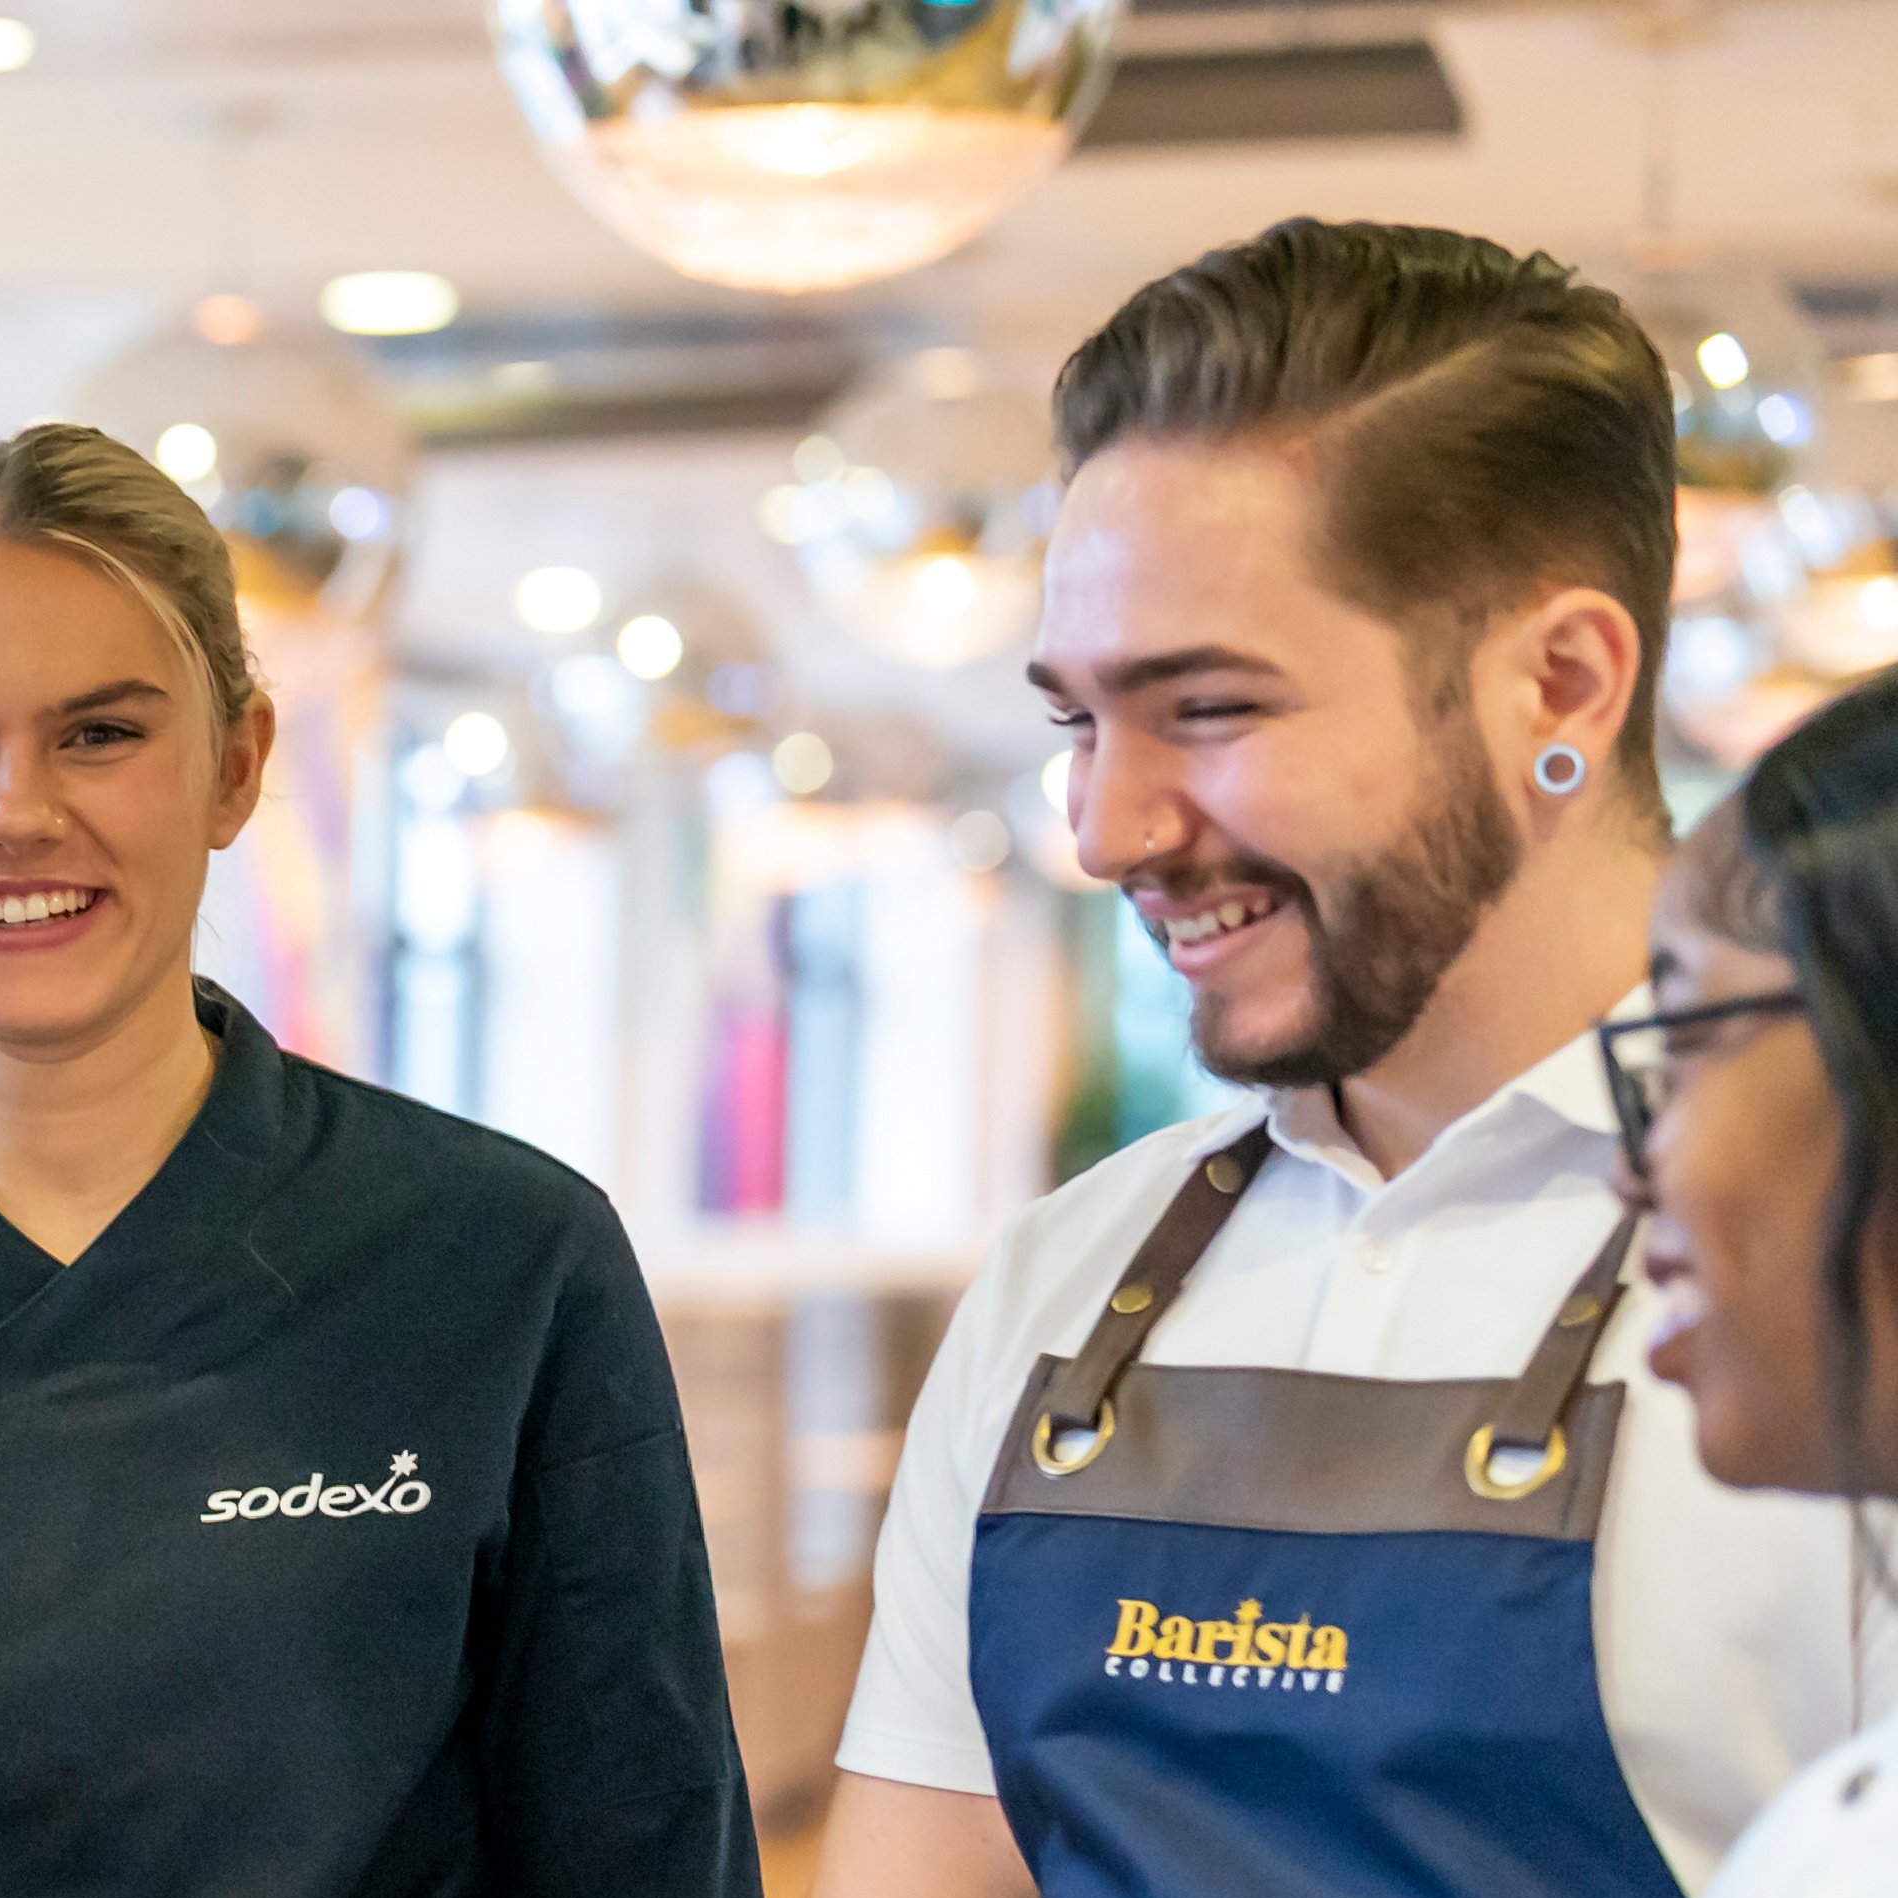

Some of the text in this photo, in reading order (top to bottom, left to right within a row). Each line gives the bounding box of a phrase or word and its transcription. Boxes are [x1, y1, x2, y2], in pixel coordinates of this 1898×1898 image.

[199, 1449, 432, 1524] sodexo
[1105, 1598, 1348, 1671] Barista
[1104, 1656, 1345, 1694] COLLECTIVE
